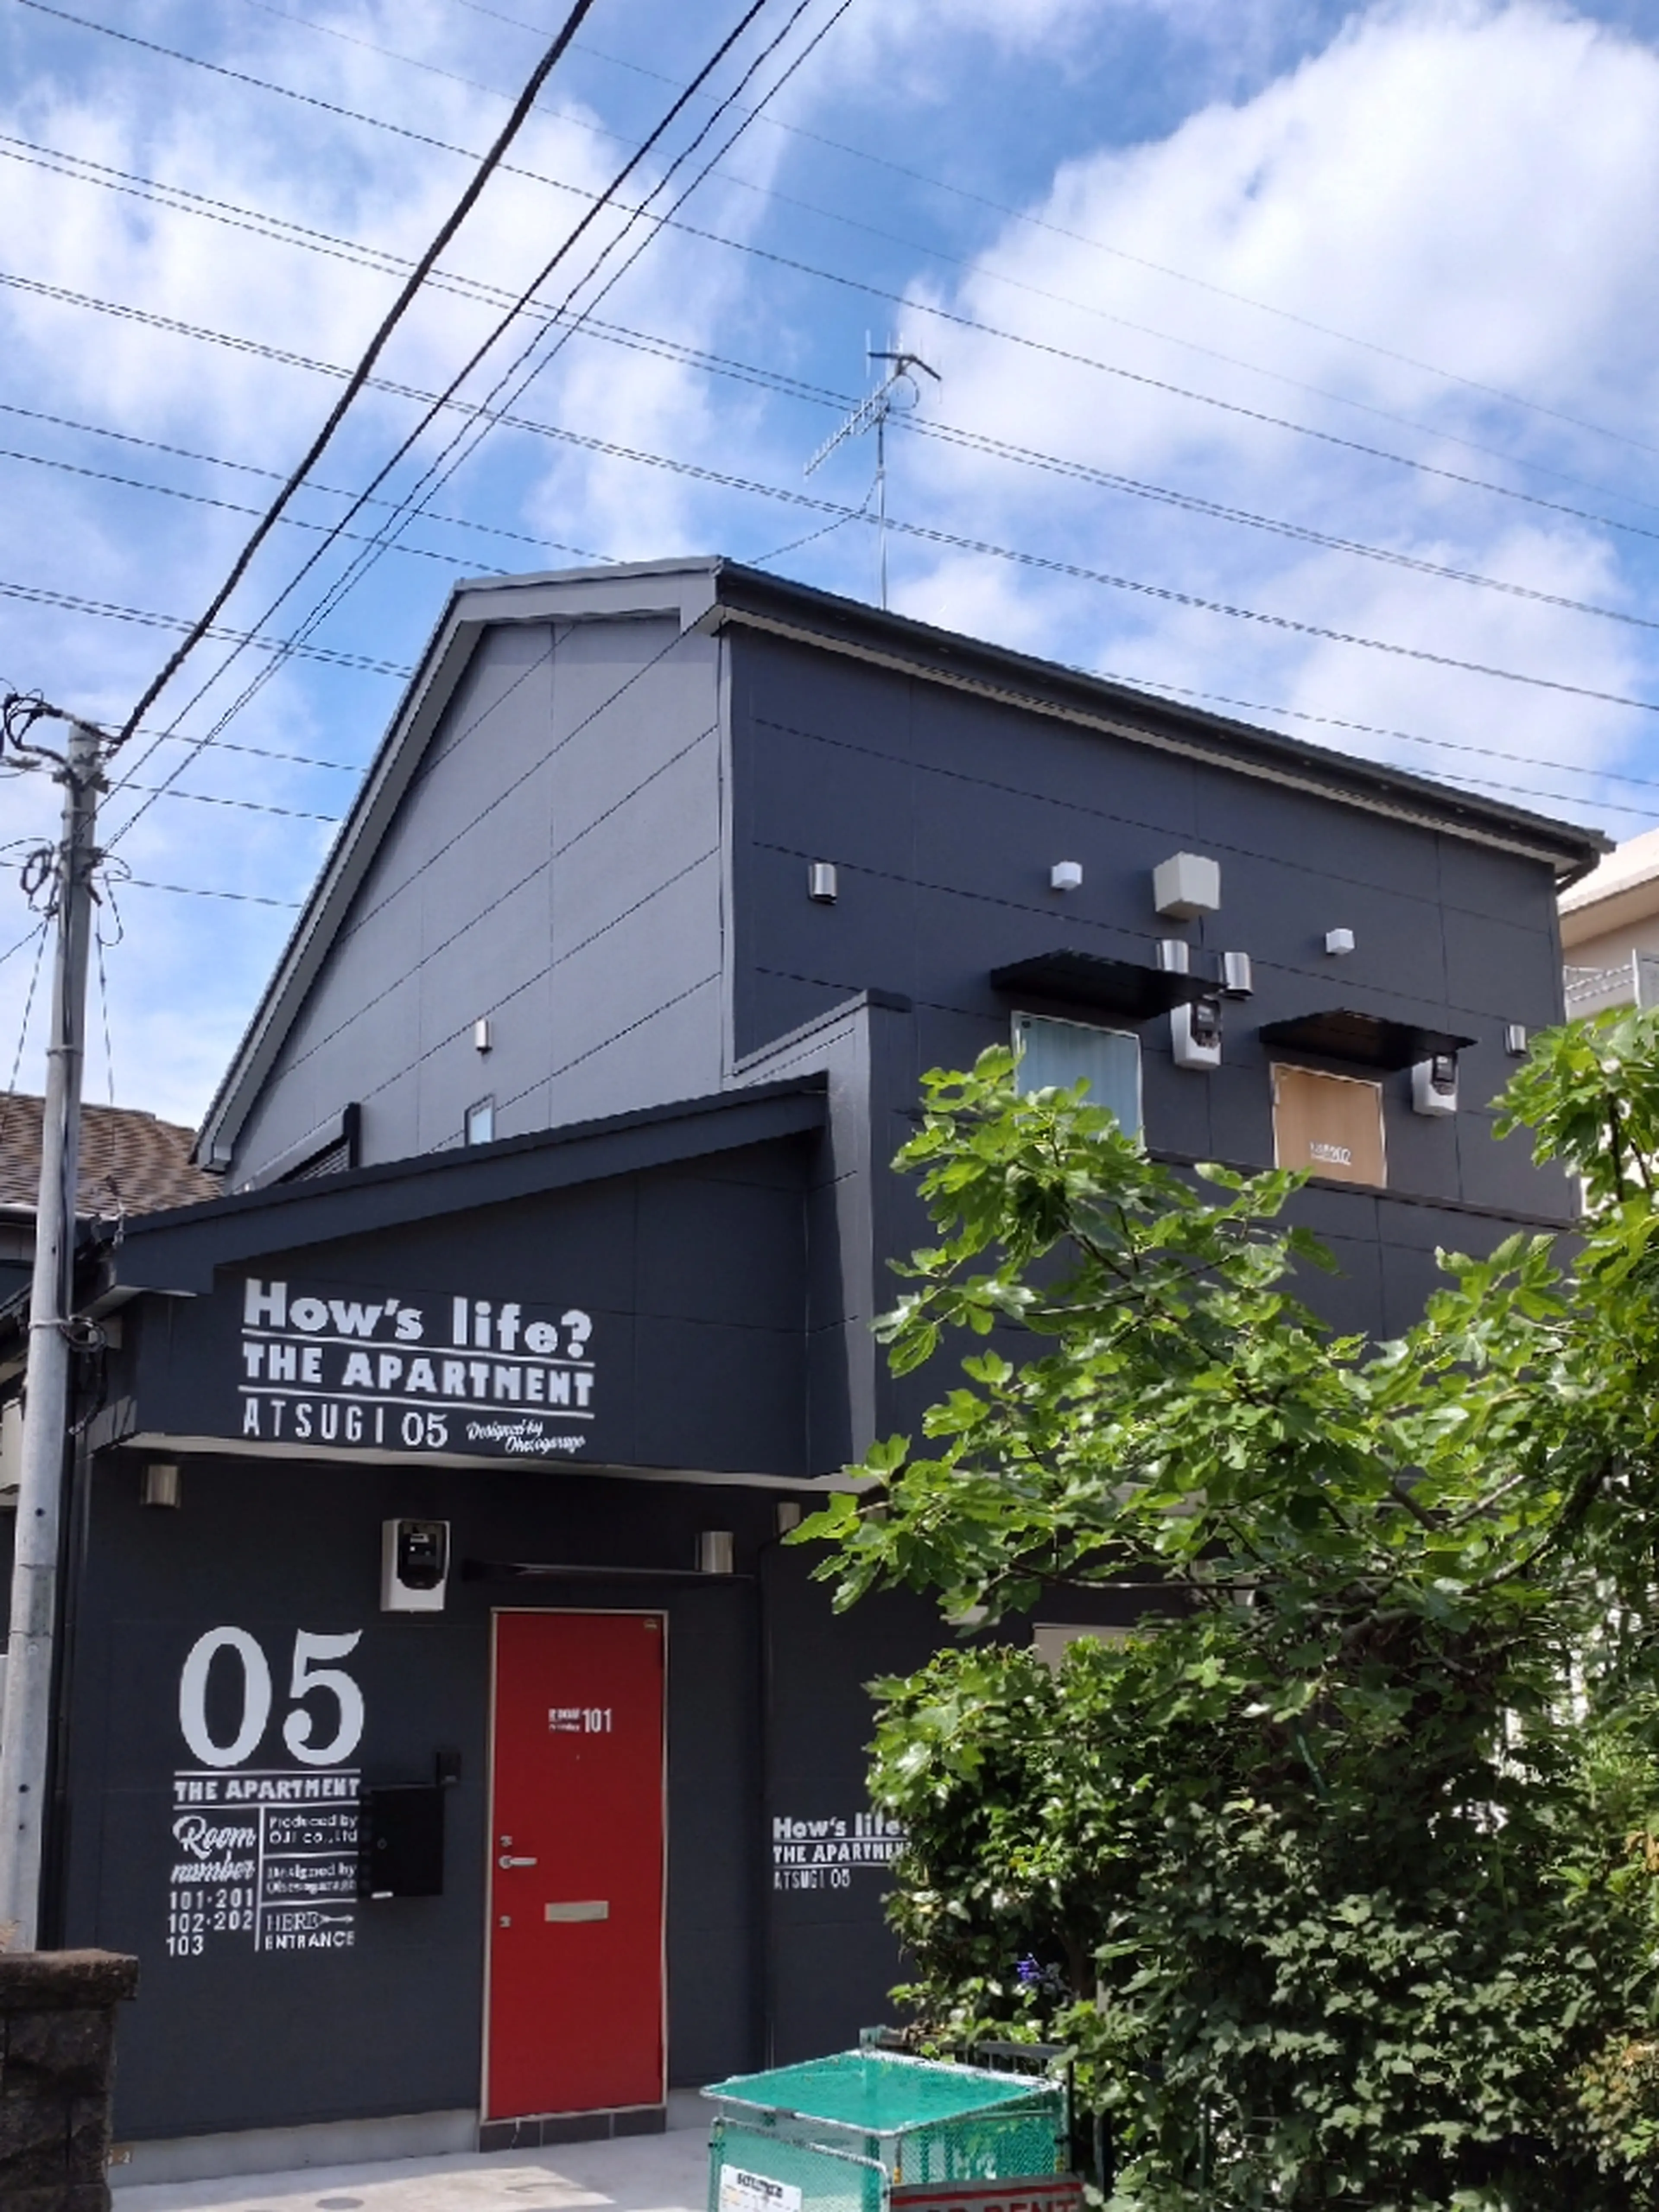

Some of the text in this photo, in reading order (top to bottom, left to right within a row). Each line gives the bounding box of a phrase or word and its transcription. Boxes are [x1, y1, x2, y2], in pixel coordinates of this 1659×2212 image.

[244, 1278, 592, 1359] How's life?
[243, 1341, 594, 1406] THE APARTMENT
[243, 1397, 448, 1448] ATSUGI 05
[179, 1626, 364, 1767] 05
[582, 1708, 612, 1733] 101
[174, 1778, 360, 1802] THE APARTMENT
[339, 1814, 359, 1828] by
[773, 1816, 846, 1840] How's
[173, 1815, 256, 1859] Room
[773, 1845, 807, 1863] THE
[171, 1850, 255, 1884] number
[166, 1935, 203, 1957] 103
[265, 1930, 355, 1951] ENTRANCE
